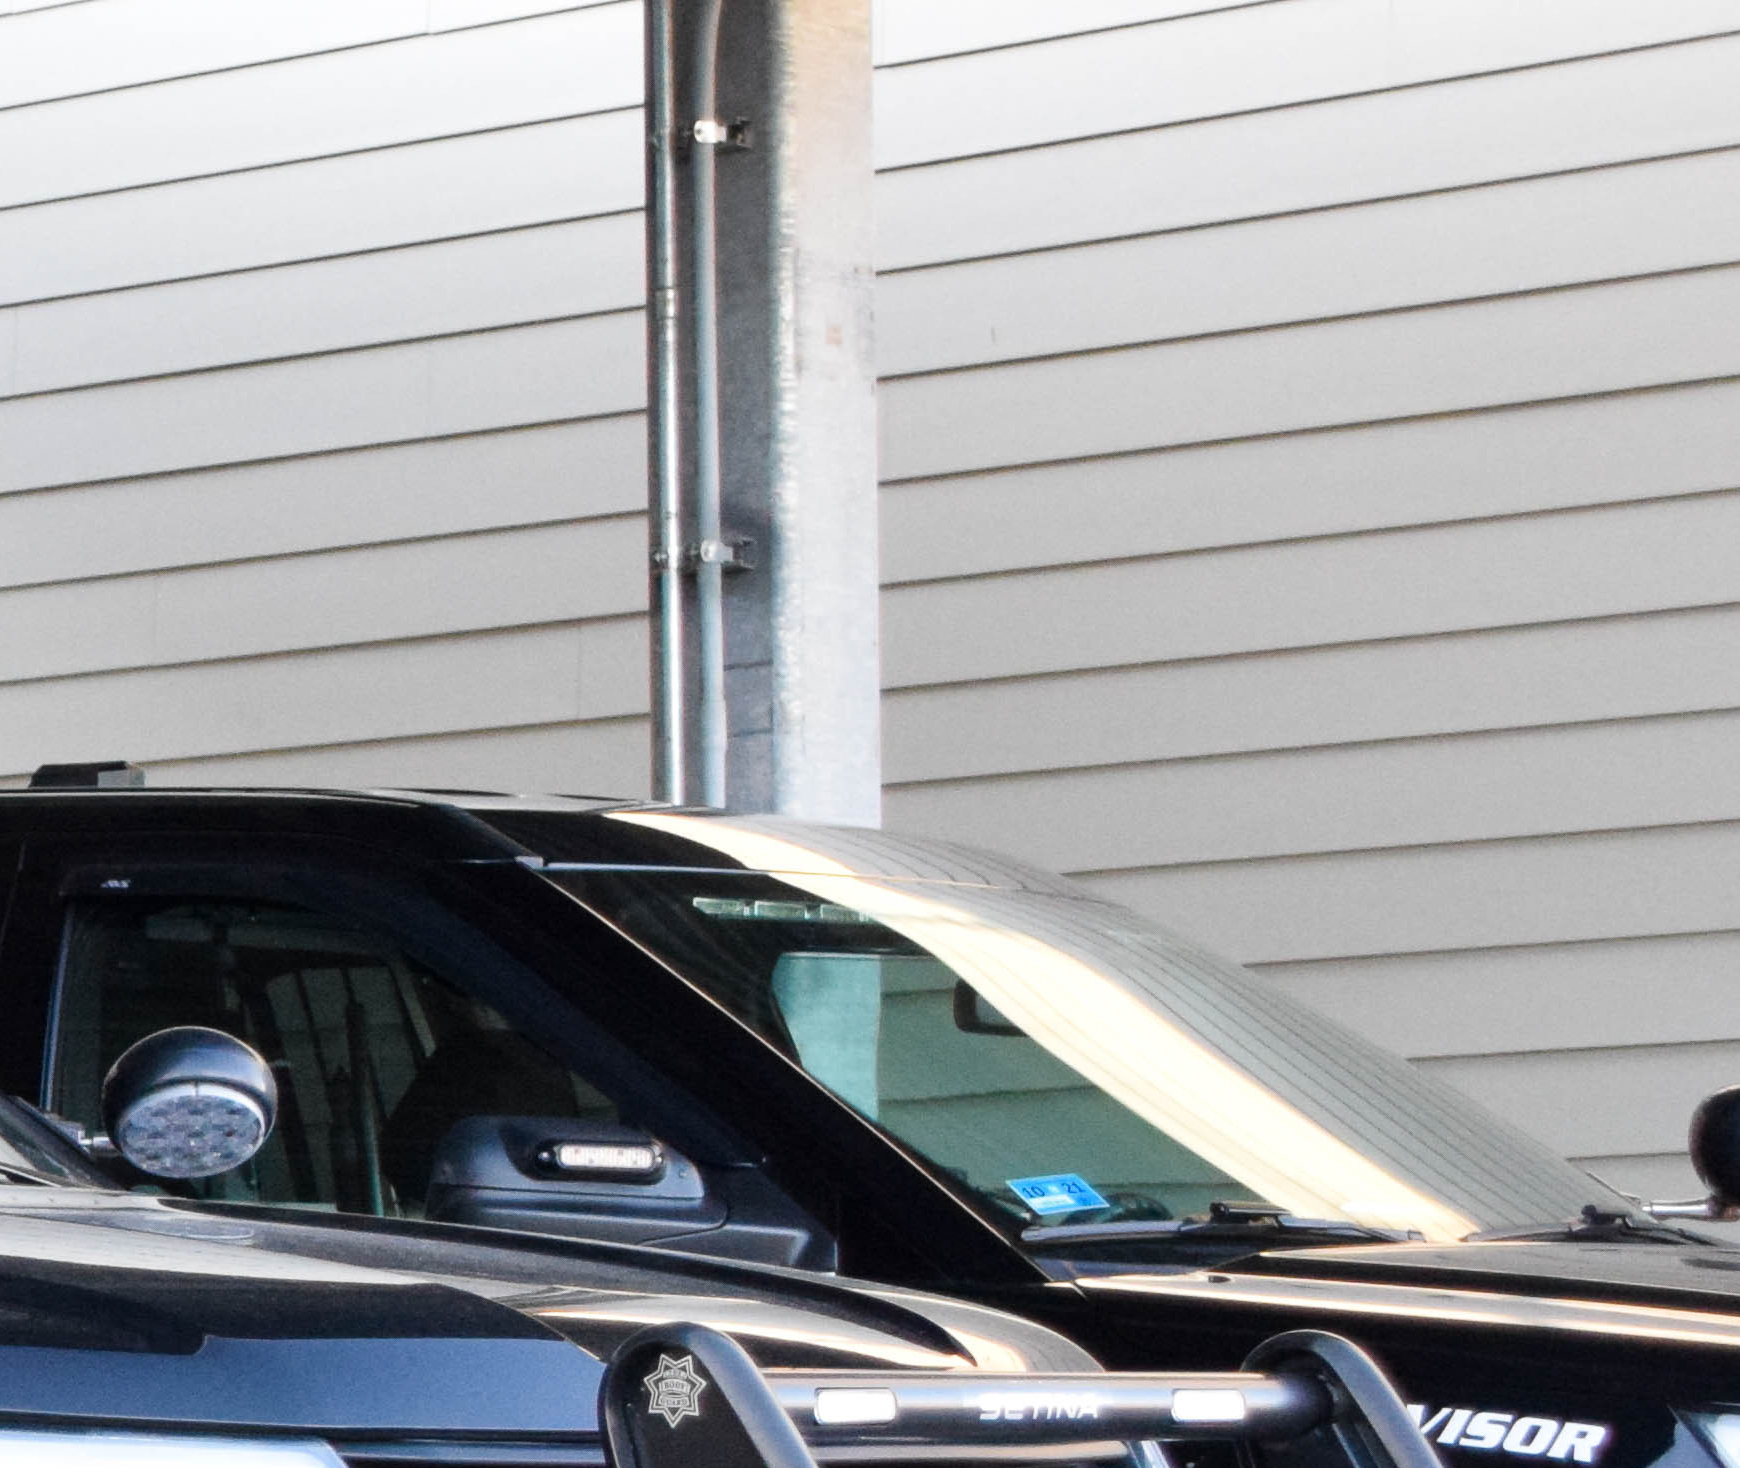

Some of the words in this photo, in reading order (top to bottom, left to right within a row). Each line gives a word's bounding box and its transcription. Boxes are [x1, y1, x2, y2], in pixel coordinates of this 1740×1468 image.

[1022, 1186, 1045, 1198] 10
[1061, 1181, 1086, 1194] 21
[979, 1392, 1098, 1420] SETINA
